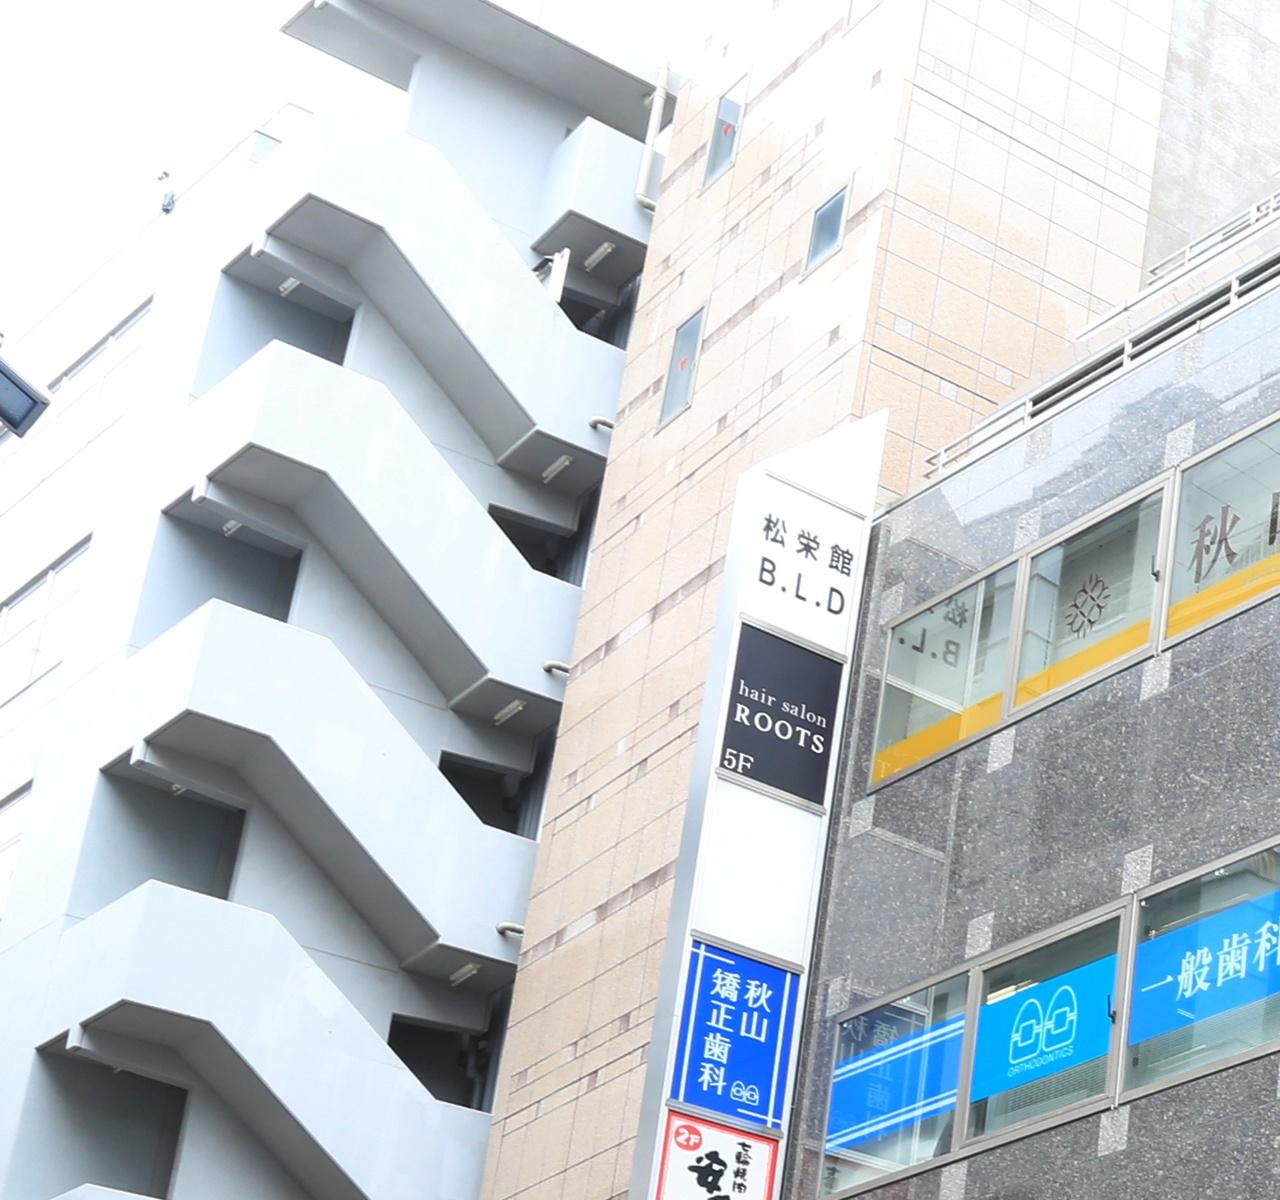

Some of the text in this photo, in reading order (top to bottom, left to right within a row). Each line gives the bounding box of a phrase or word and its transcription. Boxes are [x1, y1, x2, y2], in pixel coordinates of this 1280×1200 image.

[762, 511, 854, 577] 松栄館
[757, 556, 846, 617] B.L.D
[733, 703, 826, 756] ROOTS
[737, 679, 828, 729] hair salon
[722, 748, 755, 774] 5F
[697, 966, 741, 1097] 矯正歯科
[744, 977, 771, 1046] 秋山
[1007, 1046, 1074, 1077] ORTHODONTICS
[675, 1127, 702, 1150] 2F
[731, 1141, 753, 1195] 七輪焼肉
